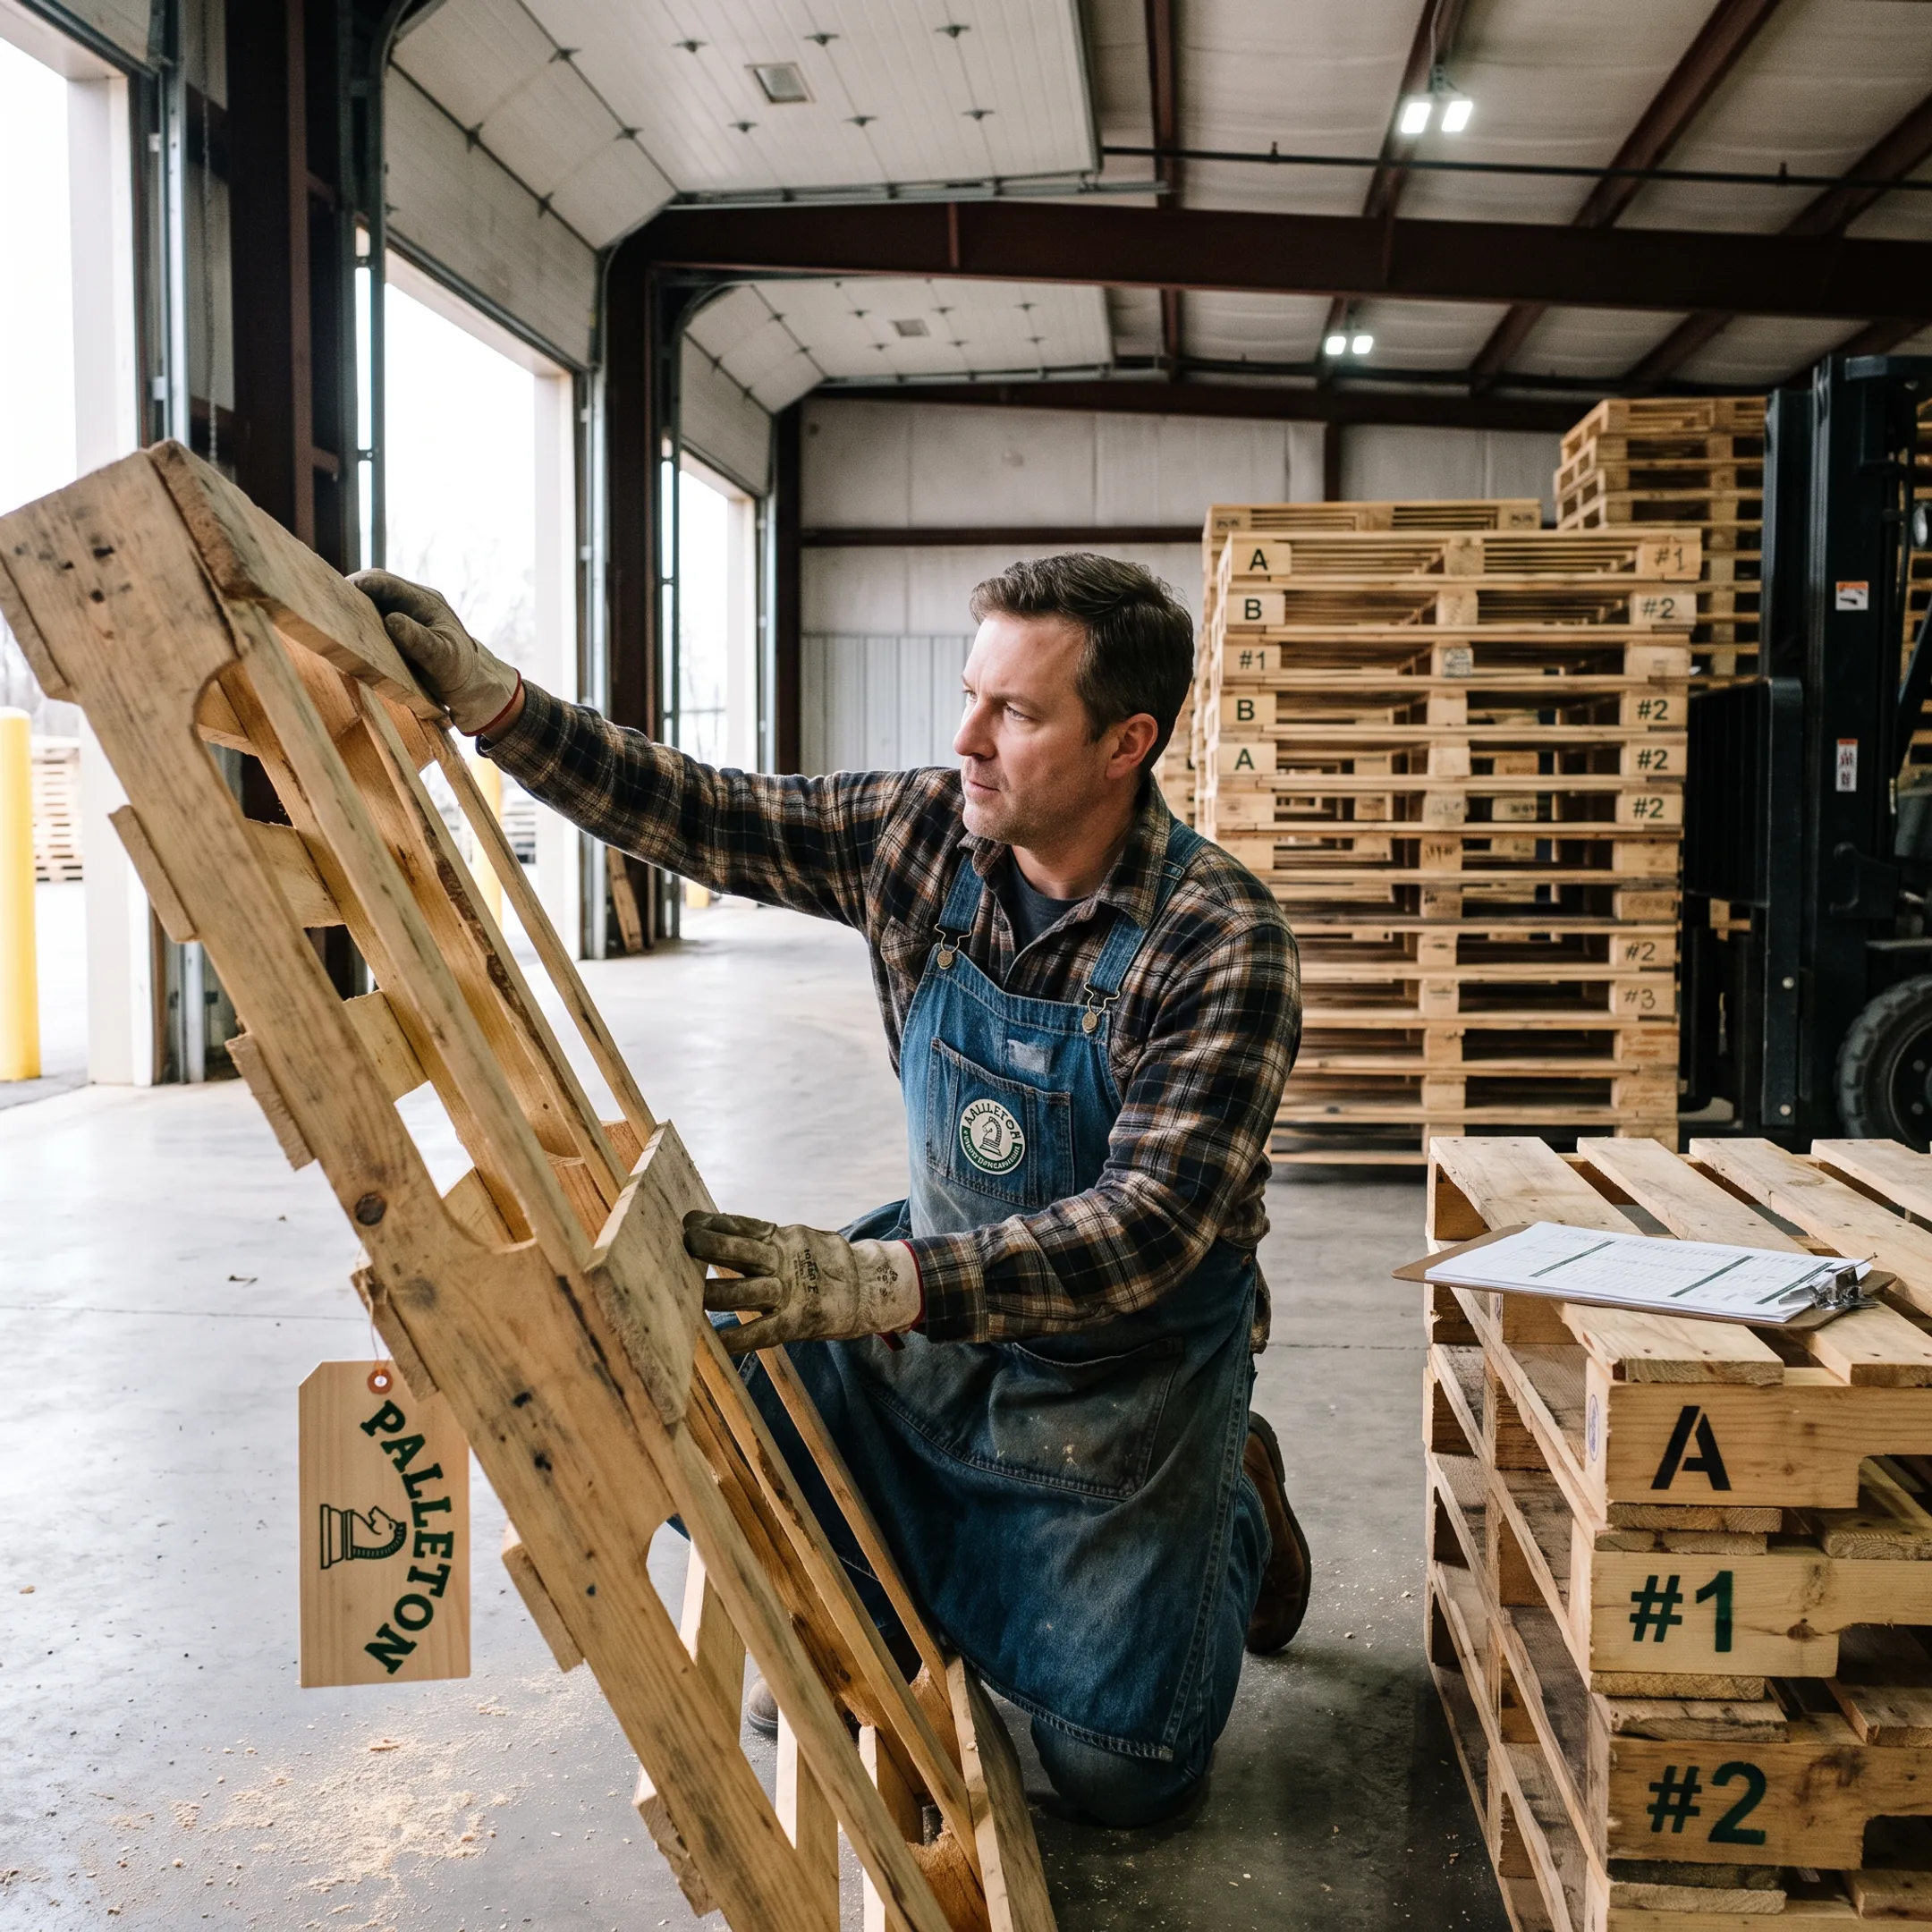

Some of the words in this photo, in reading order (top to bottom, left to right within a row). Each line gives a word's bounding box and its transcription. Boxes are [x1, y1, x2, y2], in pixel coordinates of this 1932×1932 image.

[1250, 548, 1267, 571] A
[1655, 547, 1684, 572] #1
[1245, 598, 1262, 621] B
[1642, 597, 1675, 620] #2
[1240, 650, 1266, 670] #1
[1238, 699, 1255, 721] B
[1638, 699, 1668, 720] #2
[1235, 749, 1255, 771] A
[1638, 750, 1668, 770] #2
[1633, 798, 1664, 818] #2
[1626, 942, 1656, 962] #2
[1624, 988, 1656, 1010] #3
[1650, 1405, 1732, 1491] A
[360, 1400, 454, 1675] PALLETON
[1630, 1571, 1733, 1652] #1
[1647, 1761, 1767, 1845] #2
